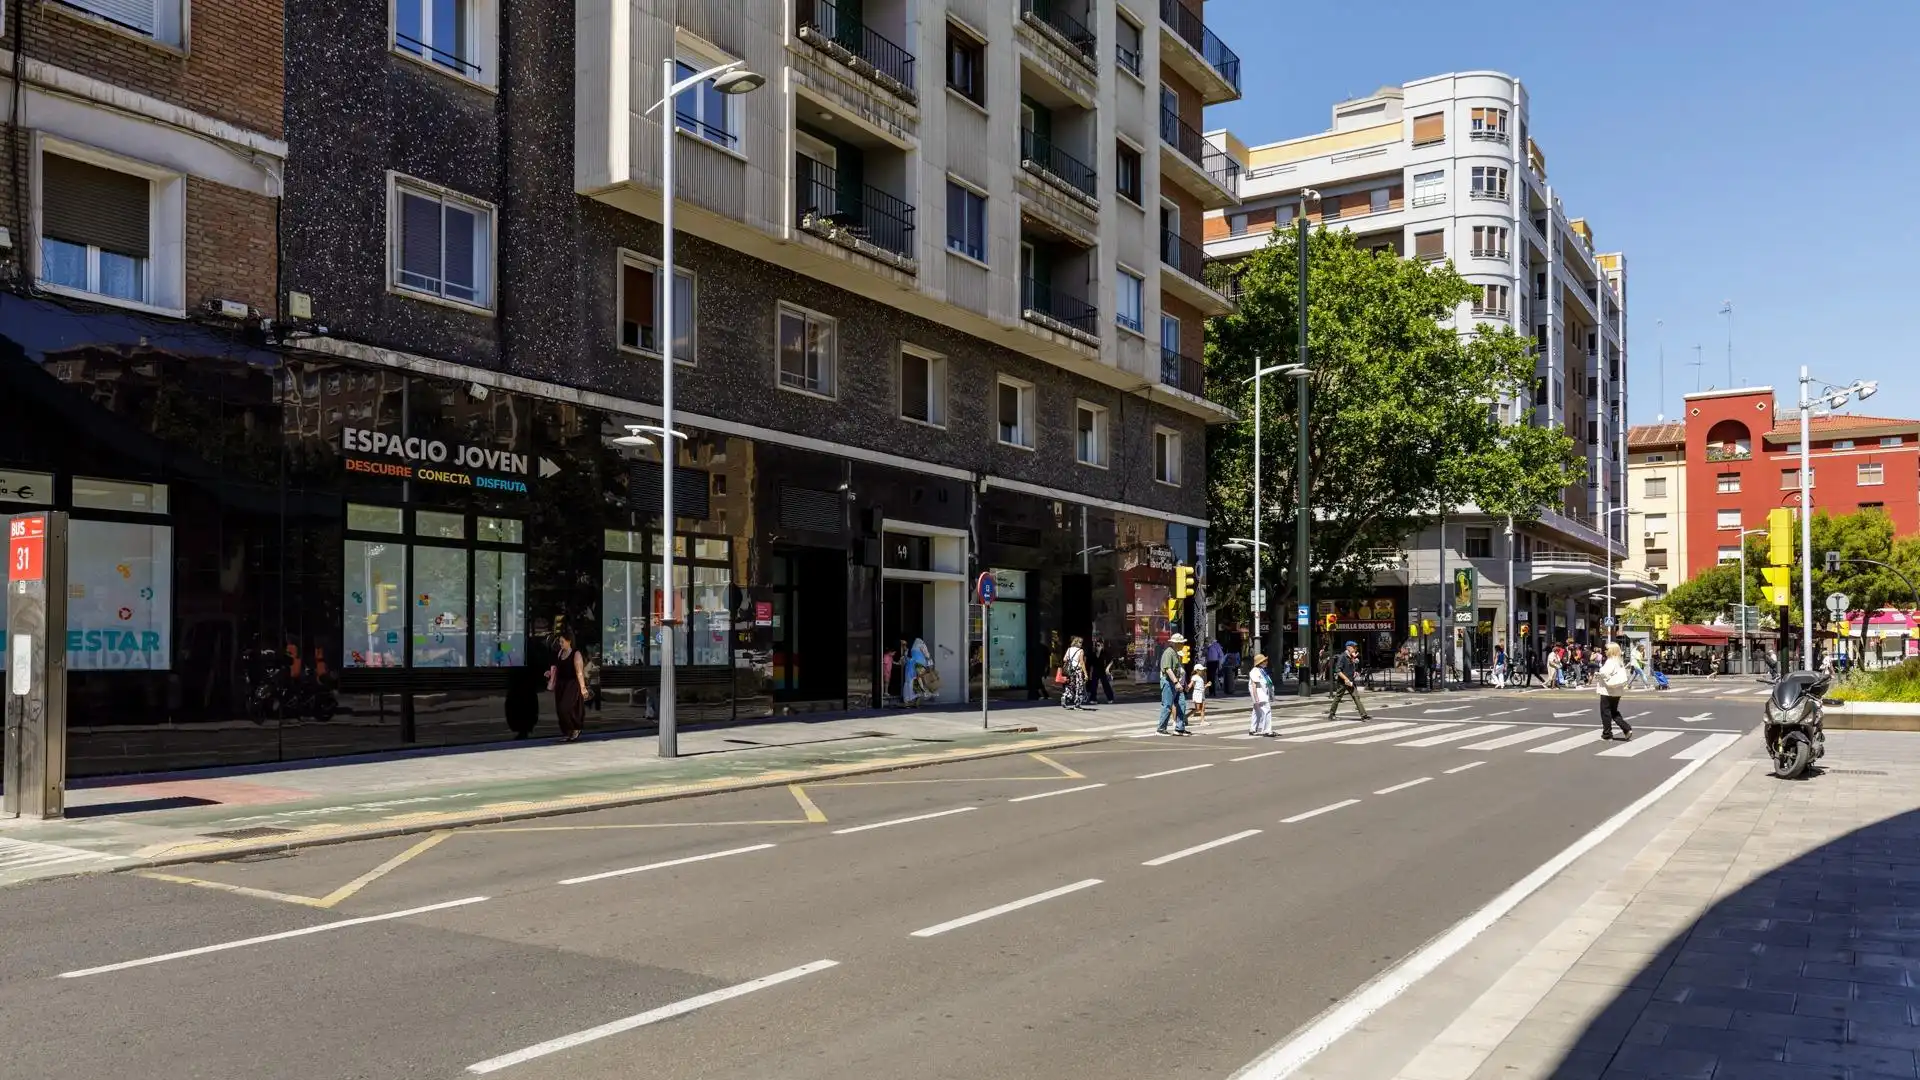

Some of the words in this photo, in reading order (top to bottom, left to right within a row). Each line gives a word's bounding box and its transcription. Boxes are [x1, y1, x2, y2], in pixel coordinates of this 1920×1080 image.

[343, 427, 447, 463] ESPACIO
[453, 445, 528, 475] JOVEN
[345, 459, 412, 478] DESCUBRE
[417, 469, 471, 486] CONECTA
[476, 476, 527, 493] DISFRUTA
[11, 521, 26, 537] BUS
[16, 547, 30, 570] 31
